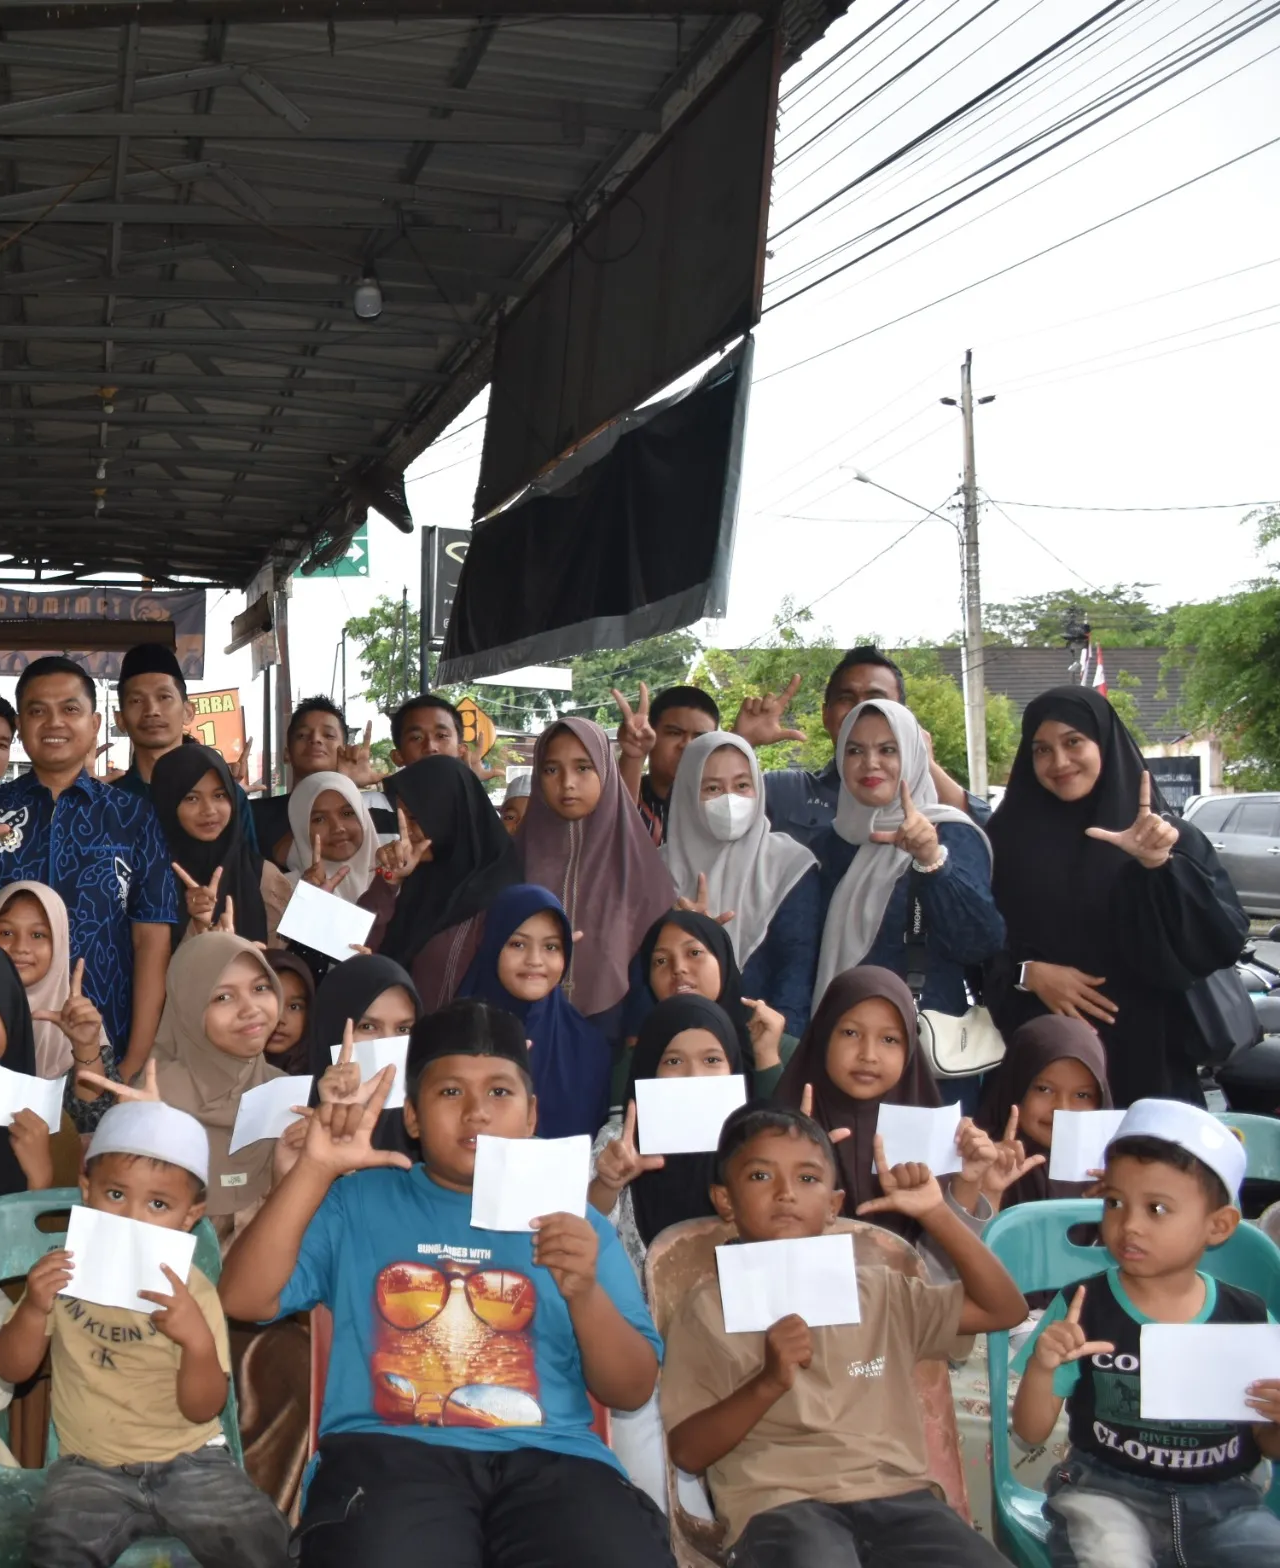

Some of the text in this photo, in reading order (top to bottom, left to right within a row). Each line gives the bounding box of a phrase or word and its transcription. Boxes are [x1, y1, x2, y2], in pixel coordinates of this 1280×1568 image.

[469, 1248, 491, 1260] WITH
[83, 1318, 143, 1343] KLEIN
[1092, 1420, 1240, 1469] CLOTHING
[1139, 1431, 1199, 1447] RIVETED
